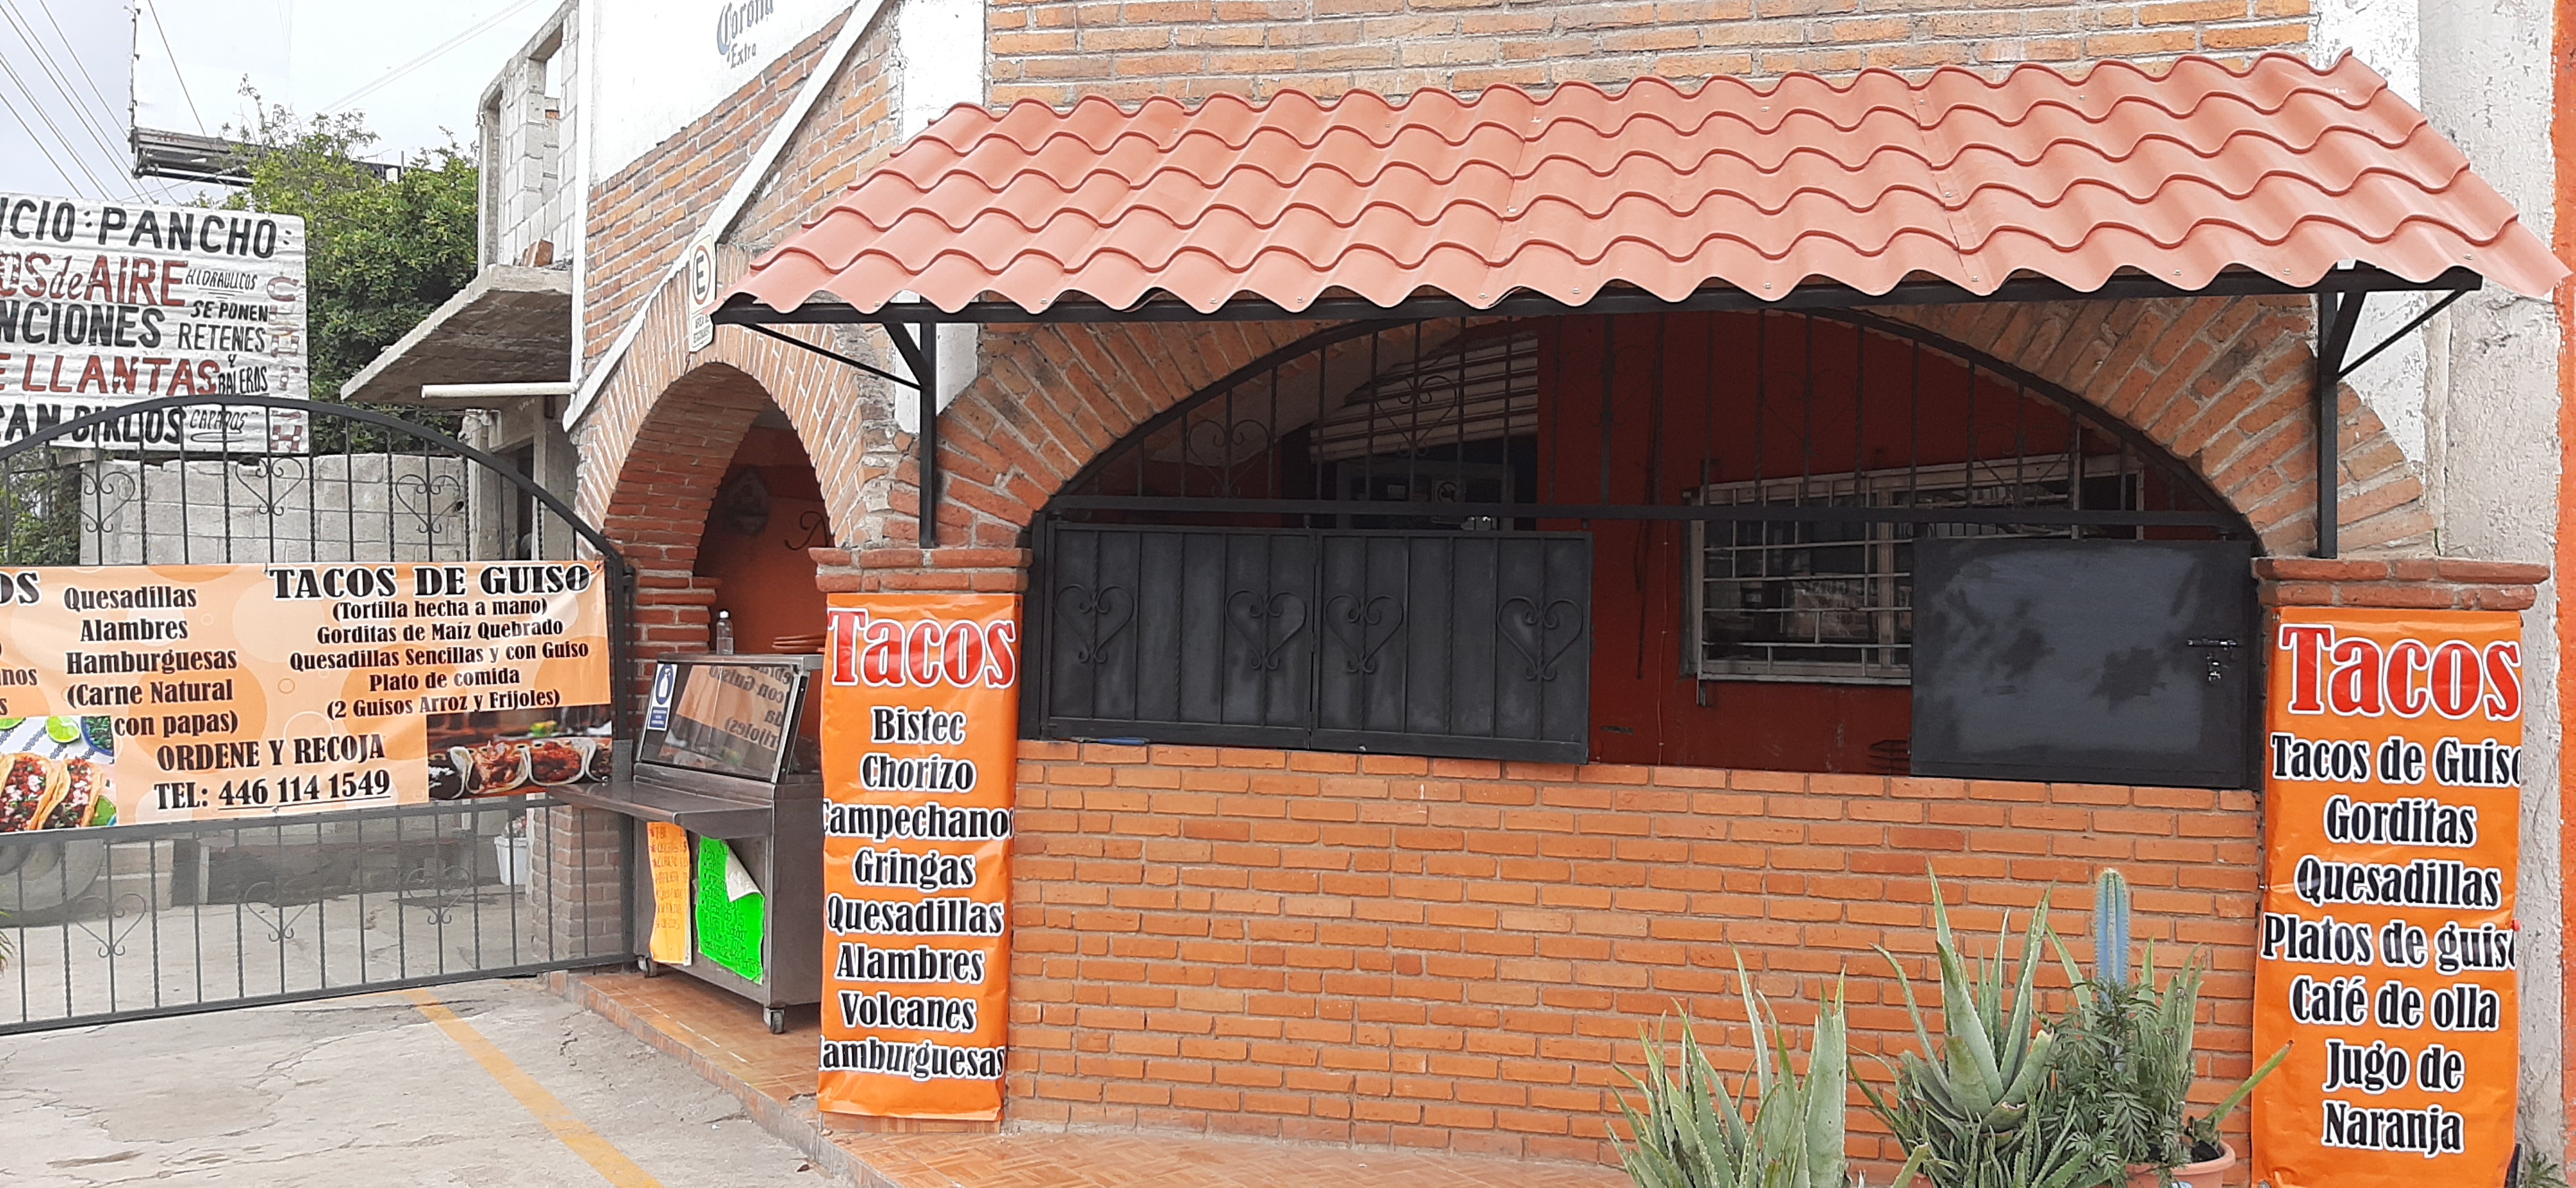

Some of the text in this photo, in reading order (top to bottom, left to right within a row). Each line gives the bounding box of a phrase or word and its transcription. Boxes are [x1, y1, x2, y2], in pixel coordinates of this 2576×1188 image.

[49, 255, 82, 300] de
[84, 254, 188, 306] AIRE
[696, 254, 706, 296] E
[191, 300, 269, 322] SE PONEN
[178, 323, 266, 352] RETENES
[23, 354, 220, 396] LLANTAS
[64, 586, 197, 609] Quesadillas
[269, 564, 591, 599] TACOS DE GUISO
[332, 598, 548, 622] (Tortilla hecha a mano)
[80, 618, 188, 642] Alambres
[317, 623, 397, 645] Gorditas
[403, 623, 426, 642] de
[477, 618, 564, 640] Quebrado
[828, 608, 1016, 687] Tacos
[66, 649, 237, 675] Hamburguesas
[290, 641, 589, 671] Quesadillas Sencillas y con Guiso
[2280, 625, 2521, 718] Tacos
[67, 679, 233, 709] (Carne Natural
[369, 667, 520, 693] Plato de comida
[327, 688, 561, 720] (2 Guisos Arroz y Frijoles)
[114, 709, 238, 738] con papas)
[873, 707, 966, 742] Bistec
[157, 733, 385, 771] ORDENE Y RECOJA
[2271, 734, 2369, 780] Tacos
[2380, 738, 2424, 783] de
[154, 769, 390, 810] TEL: 446 114 1549
[862, 754, 975, 790] Chorizo
[2325, 798, 2475, 845] Gorditas
[854, 848, 975, 890] Gringas
[2297, 857, 2500, 906] Quesadillas
[828, 896, 1003, 934] Quesadillas
[2262, 914, 2372, 963] Platos
[2382, 922, 2426, 966] de
[838, 944, 983, 981] Alambres
[840, 992, 976, 1030] Volcanes
[2292, 977, 2498, 1029] Café de olla
[819, 1039, 1005, 1078] amburguesas
[2325, 1041, 2463, 1091] Jugo de
[2324, 1103, 2462, 1156] Naranja
